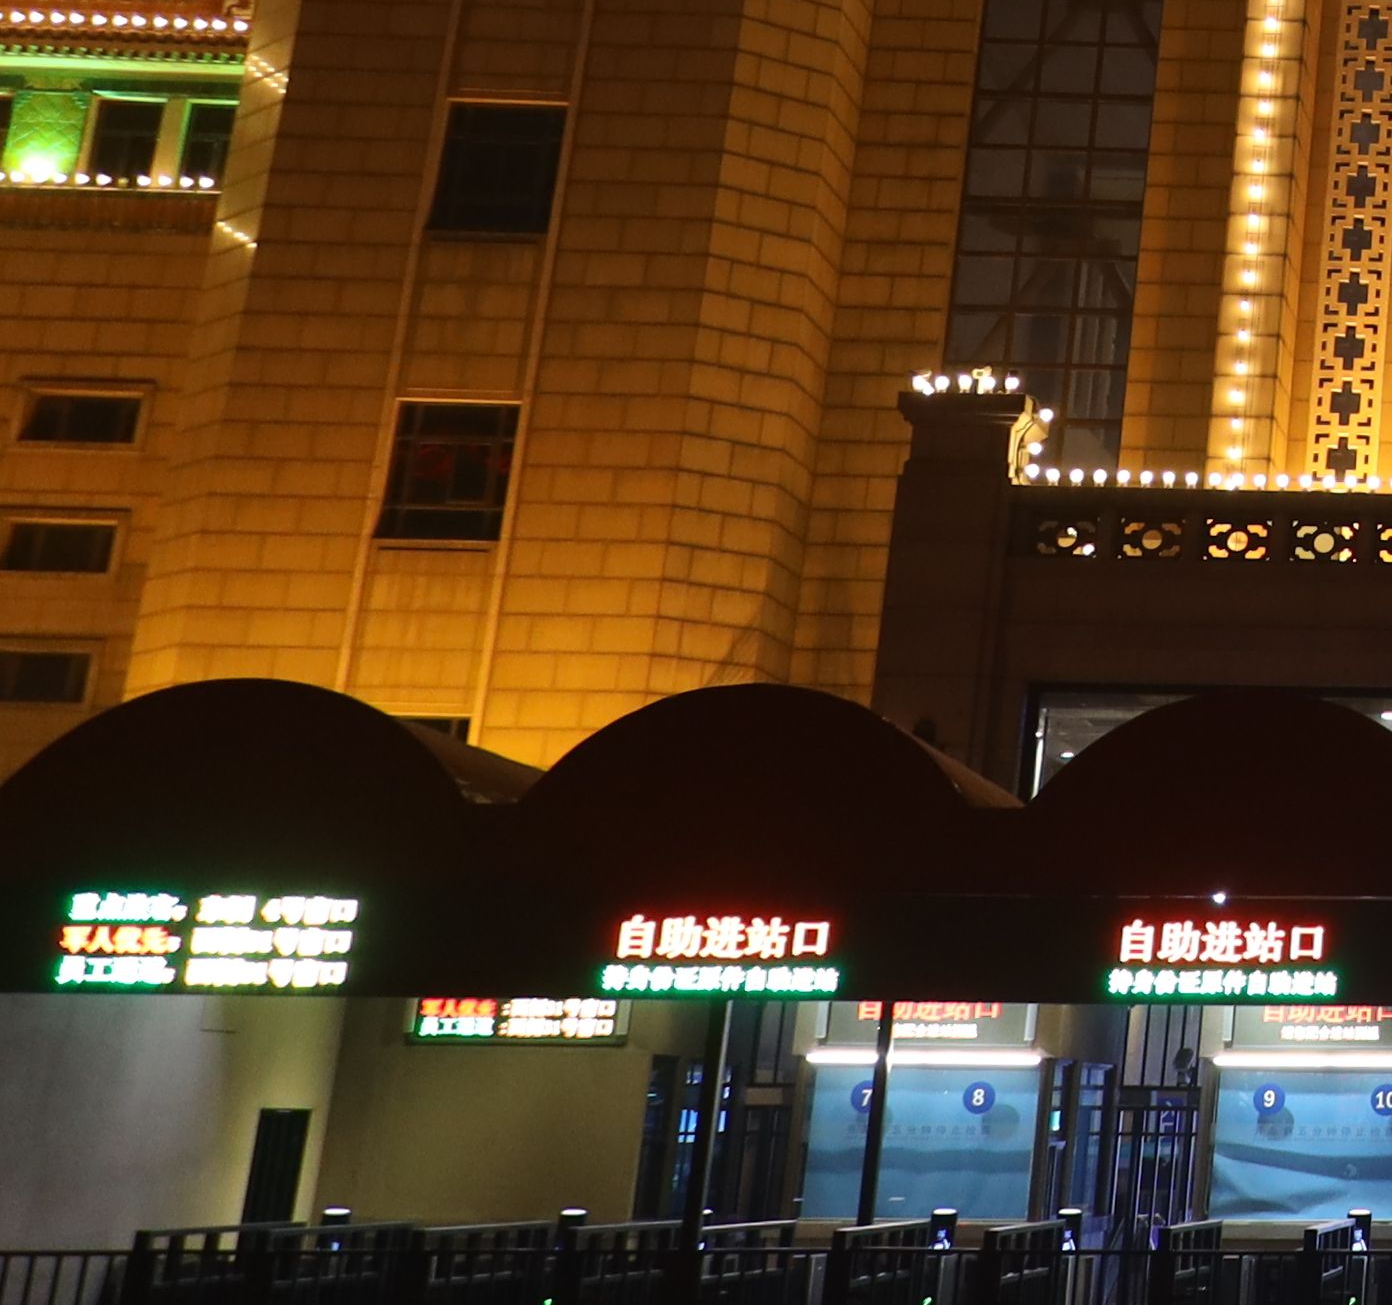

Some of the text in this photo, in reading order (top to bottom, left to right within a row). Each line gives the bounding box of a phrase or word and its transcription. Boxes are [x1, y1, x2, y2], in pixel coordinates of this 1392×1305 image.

[617, 914, 830, 959] 自助进站口
[1119, 919, 1324, 963] 自助进站口
[861, 1089, 873, 1107] 7
[972, 1089, 985, 1107] 8
[1263, 1090, 1276, 1108] 9
